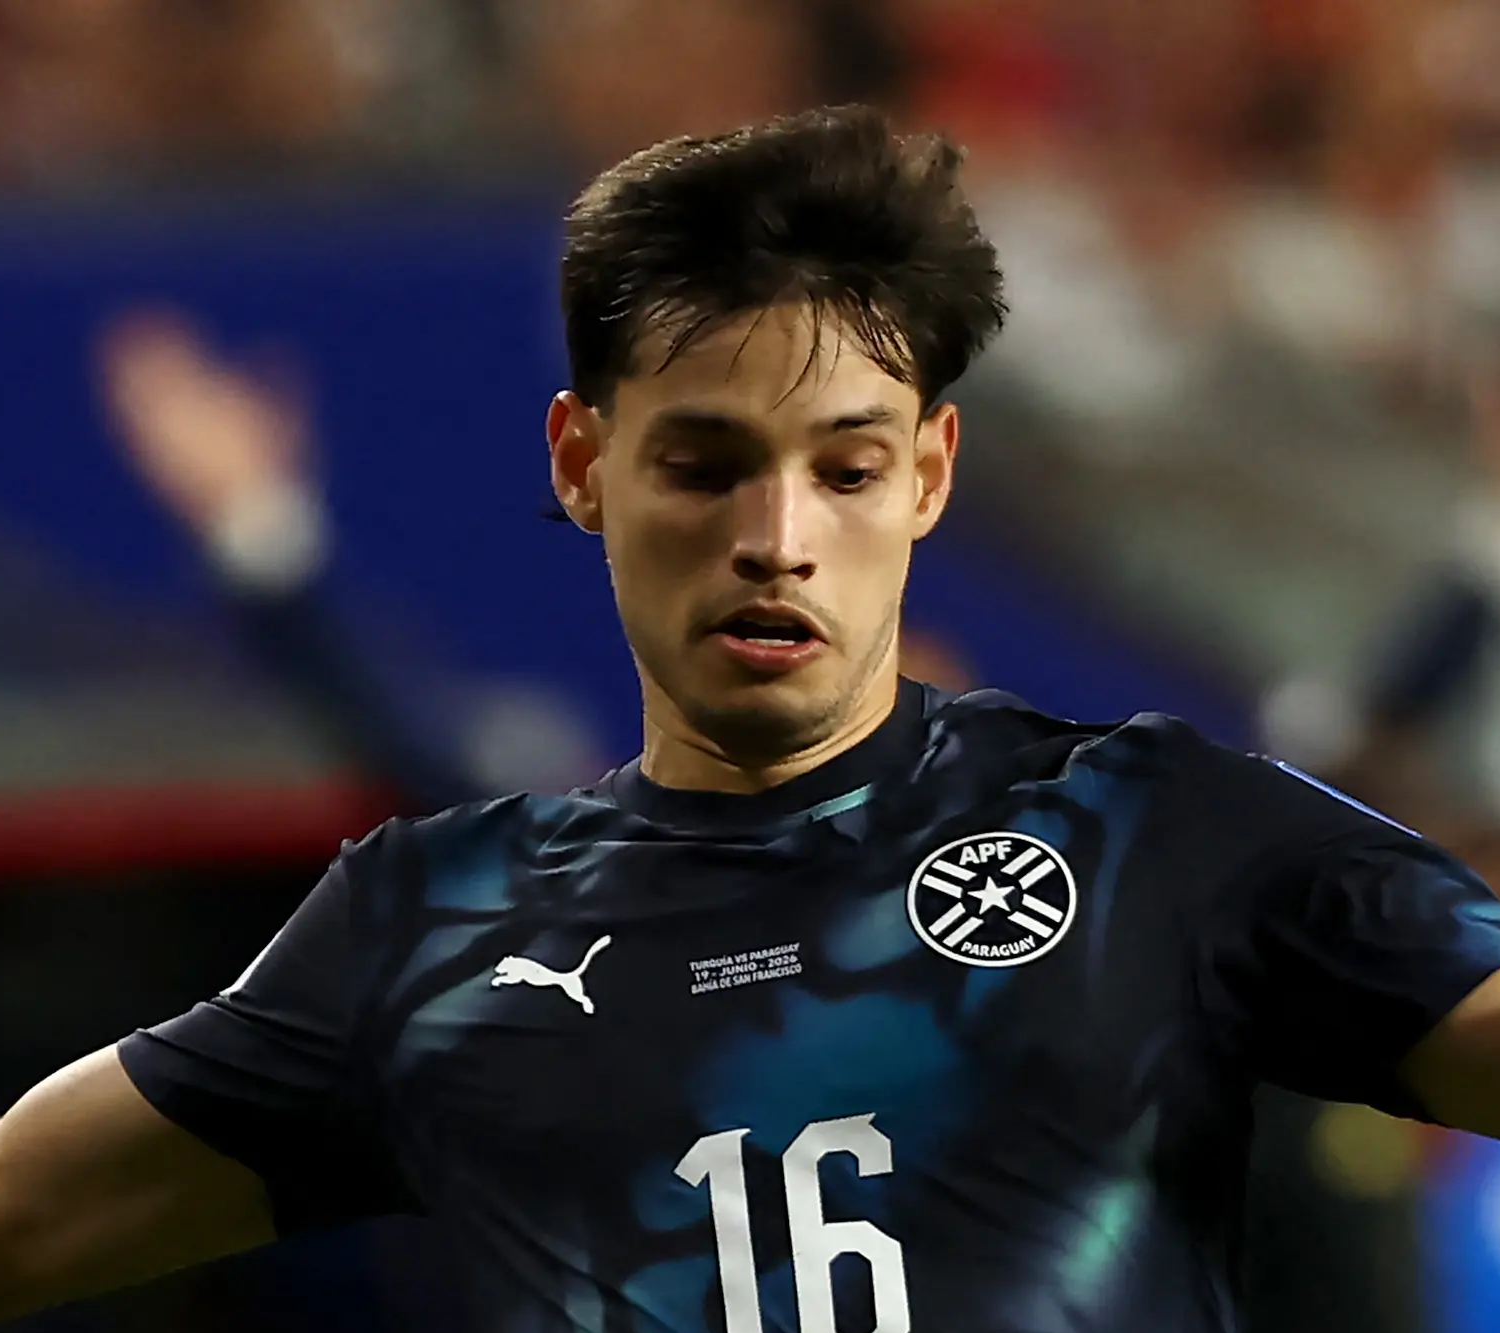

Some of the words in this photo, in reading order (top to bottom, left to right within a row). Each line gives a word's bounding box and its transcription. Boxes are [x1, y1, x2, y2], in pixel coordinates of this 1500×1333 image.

[959, 840, 1013, 865] APF
[734, 953, 748, 964] VS
[749, 942, 800, 961] PARAGUAY
[961, 935, 1036, 957] PARAGUAY
[695, 970, 709, 982] 19
[719, 962, 757, 977] JUNIO
[768, 954, 799, 968] 2026
[719, 976, 732, 988] DE
[733, 974, 751, 986] SAN
[752, 963, 802, 982] FRANCISCO
